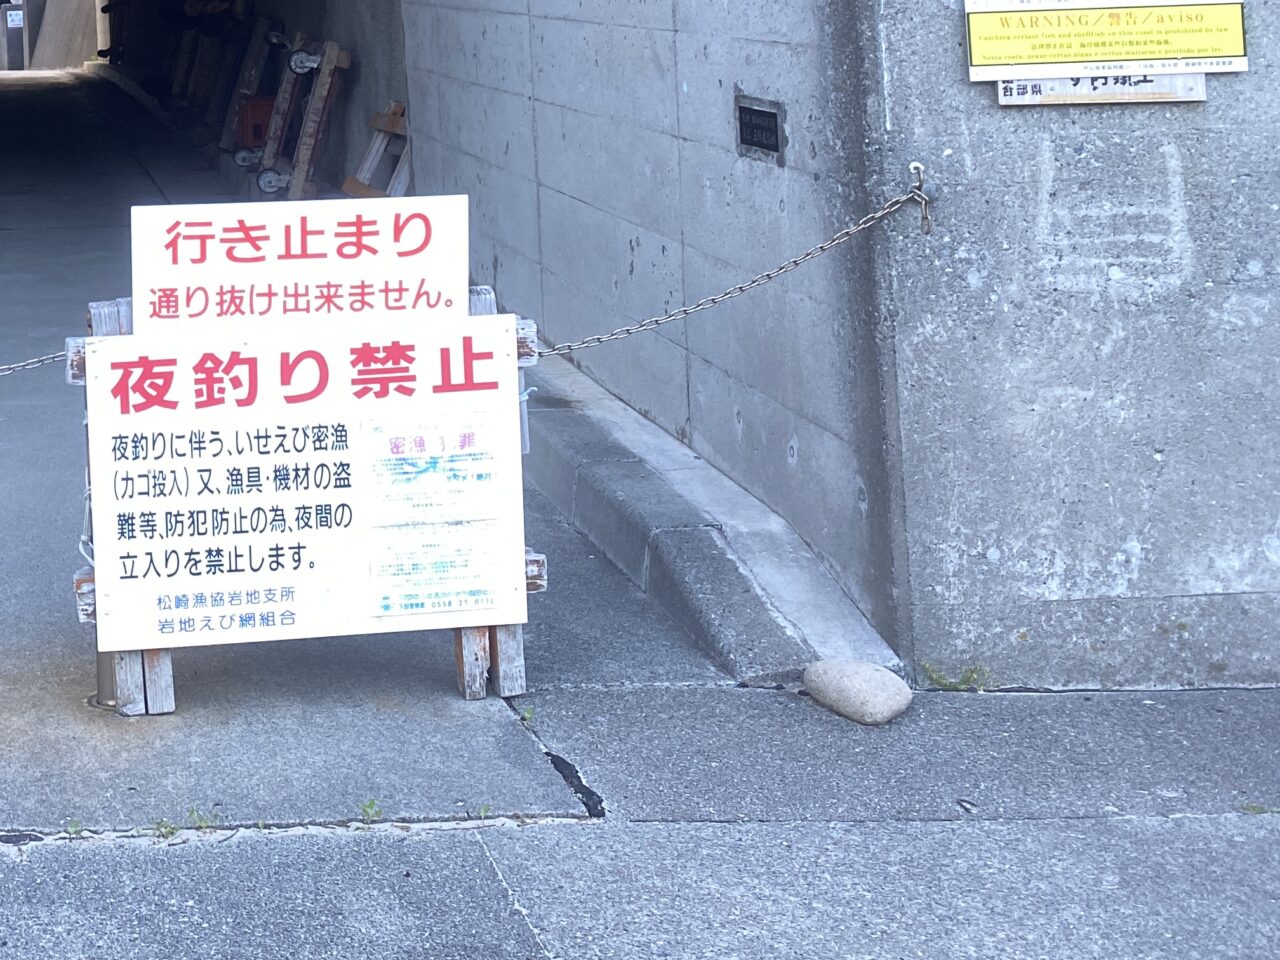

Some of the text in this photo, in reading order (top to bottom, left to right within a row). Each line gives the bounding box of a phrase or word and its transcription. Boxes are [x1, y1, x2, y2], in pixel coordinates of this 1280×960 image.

[164, 212, 433, 265] 行き止まり
[148, 278, 454, 319] 通り抜け出来ません。
[110, 336, 499, 414] 夜釣り禁止
[111, 422, 349, 462] 夜釣りに伴う、いせえび密漁
[117, 503, 353, 541] 難等、防犯防止の為、夜間の
[119, 542, 316, 579] 立入りを禁止します。
[156, 586, 296, 611] 松崎漁協岩地支所
[157, 609, 296, 634] 岩地えび網組合
